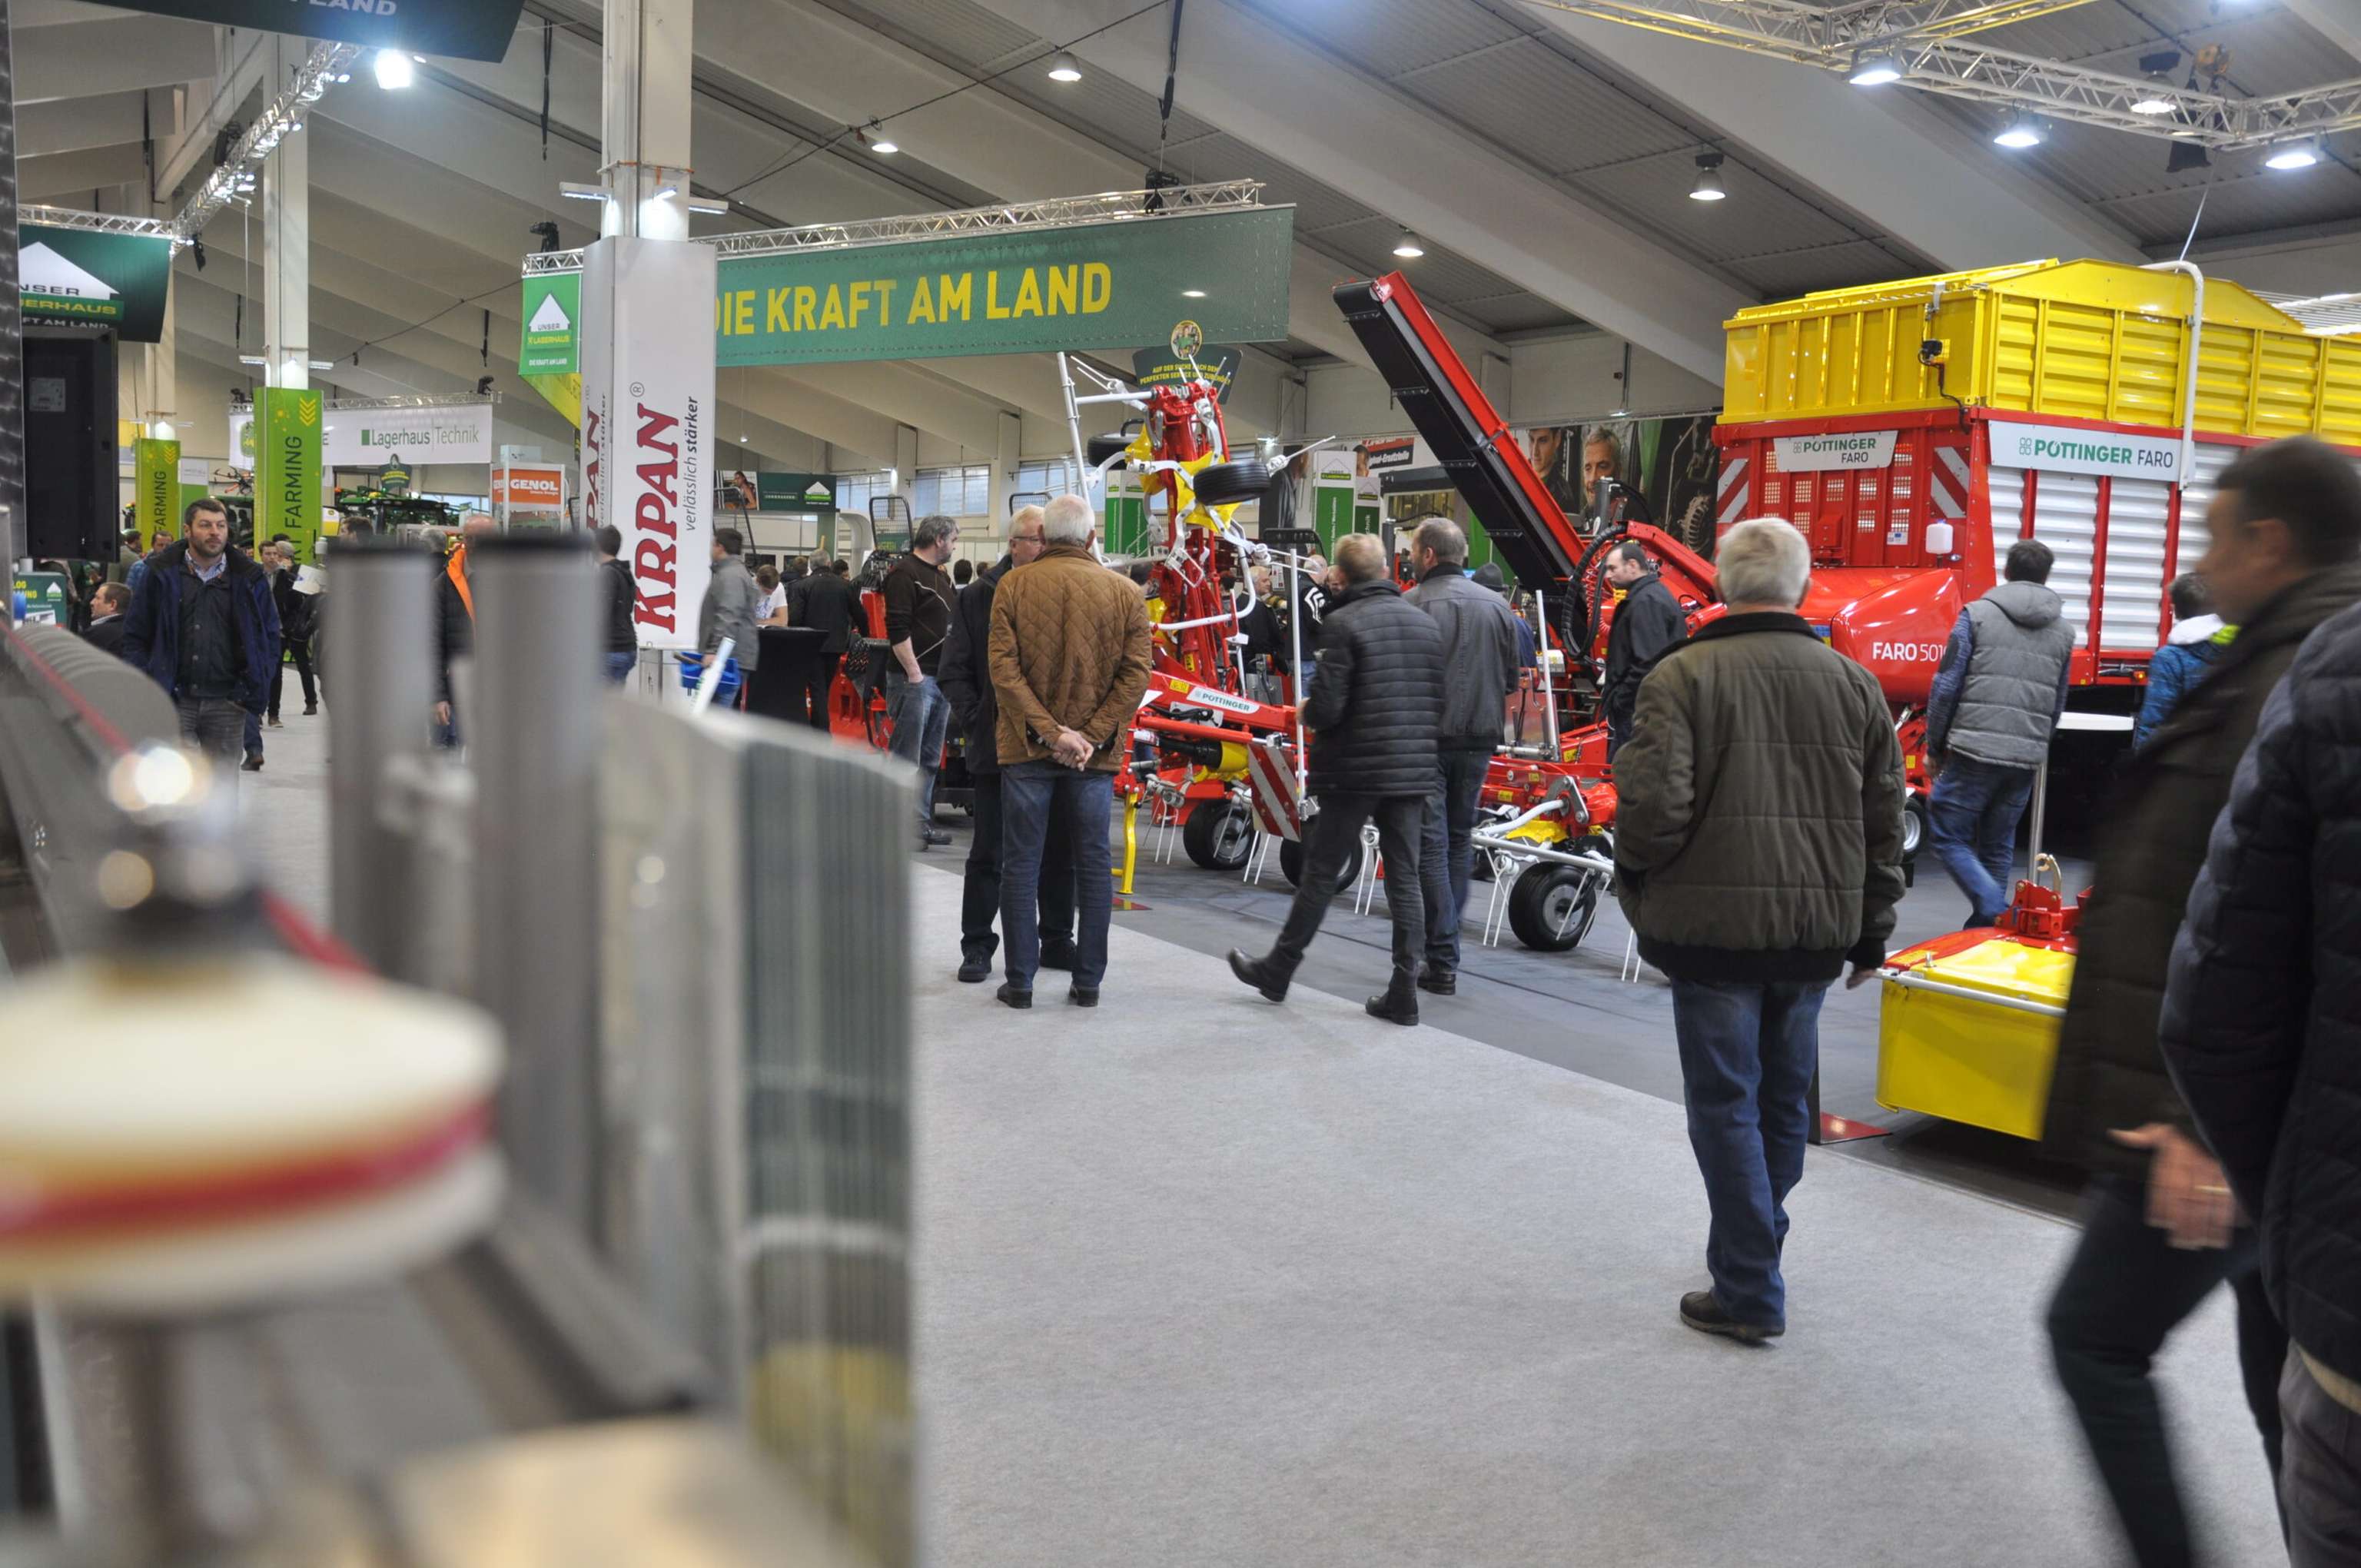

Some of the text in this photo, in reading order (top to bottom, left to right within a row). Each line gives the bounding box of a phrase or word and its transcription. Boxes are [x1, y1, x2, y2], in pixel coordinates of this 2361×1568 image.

[716, 262, 1112, 336] IE KRAFT AM LAND
[372, 424, 480, 449] Lagerhaus Technik
[682, 395, 699, 532] verlässlich stärker
[1841, 452, 1868, 463] FARO
[2137, 449, 2173, 468] FARO
[285, 436, 302, 529] FARMING
[510, 479, 559, 490] GENOL
[634, 402, 679, 634] KRPAN
[1872, 642, 1918, 661] FARO
